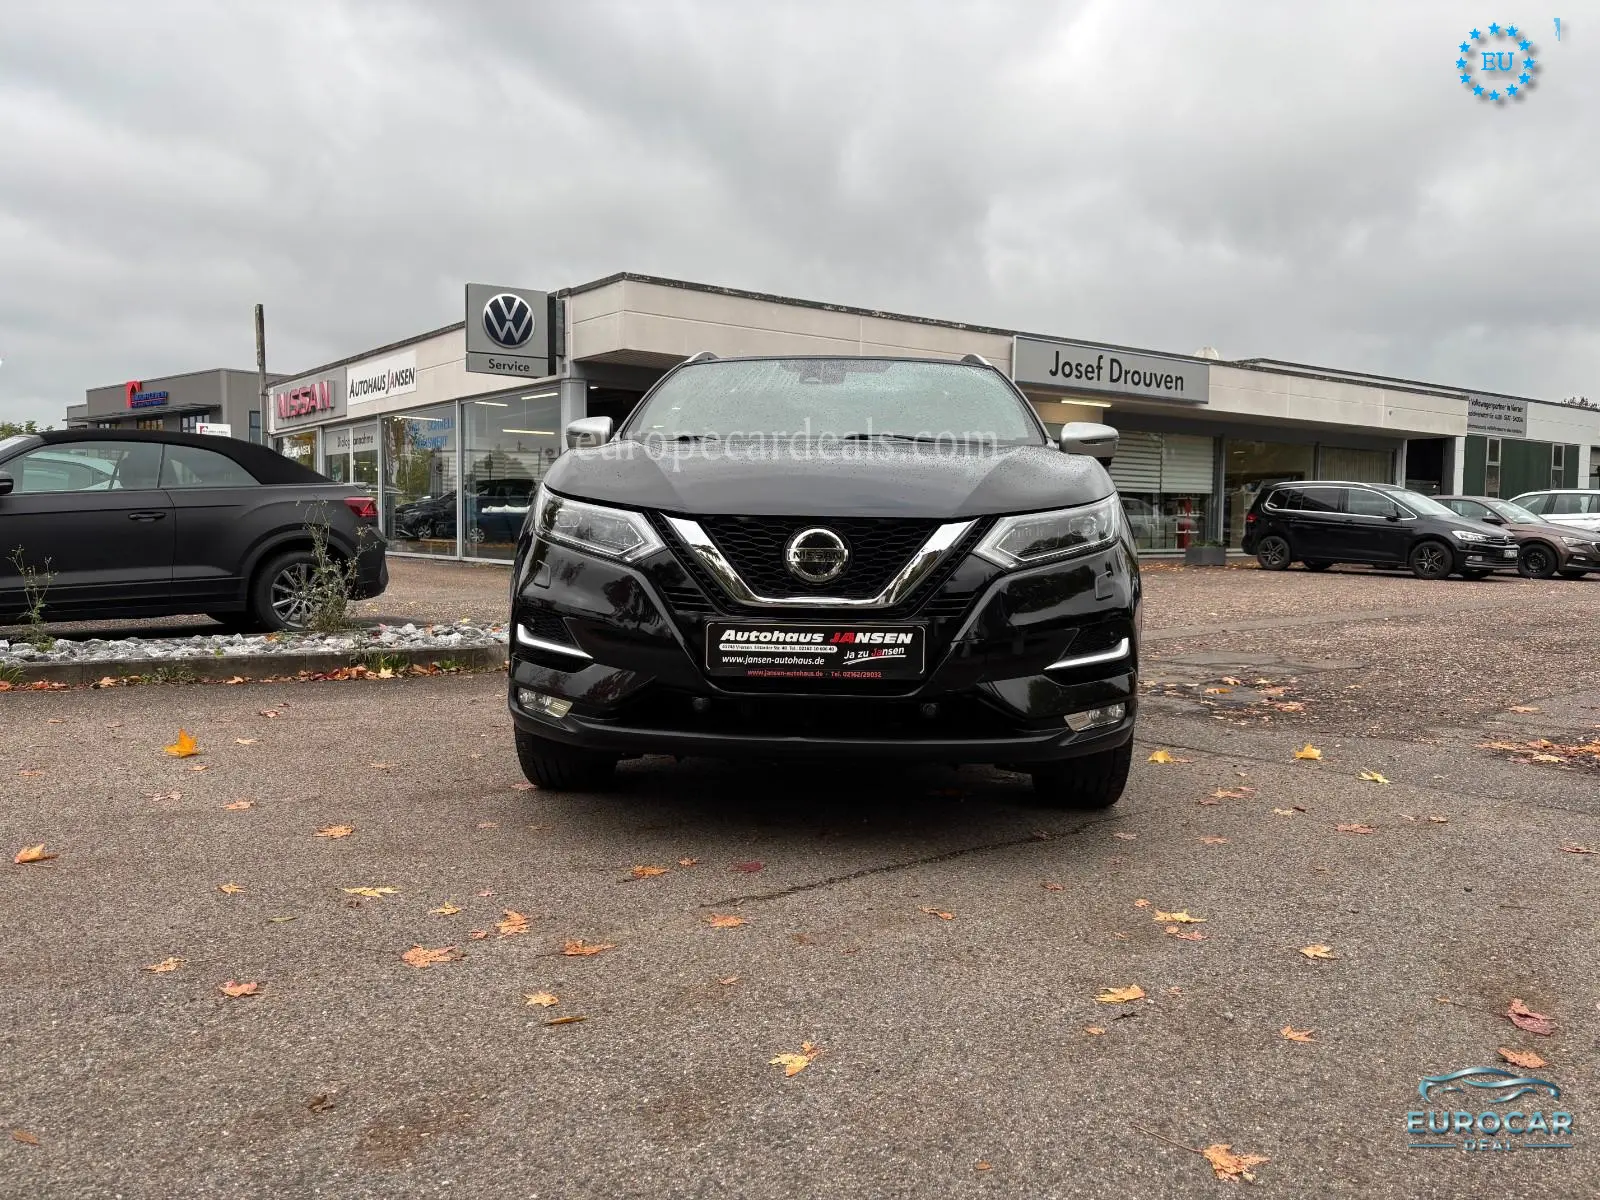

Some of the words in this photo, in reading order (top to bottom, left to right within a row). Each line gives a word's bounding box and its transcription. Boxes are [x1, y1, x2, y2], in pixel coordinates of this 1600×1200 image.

[488, 358, 530, 372] Service
[1049, 350, 1104, 381] Josef
[1109, 358, 1184, 391] Drouven
[349, 373, 386, 399] AUTOHAUS
[386, 367, 416, 394] JANSEN
[277, 380, 335, 419] NISSAN
[793, 550, 842, 561] NISSAN
[720, 629, 824, 643] Autohaus
[830, 632, 913, 644] JANSEN
[722, 655, 825, 665] www.jansen-autohaus.de
[844, 650, 855, 659] Ja
[871, 647, 905, 657] Jansen
